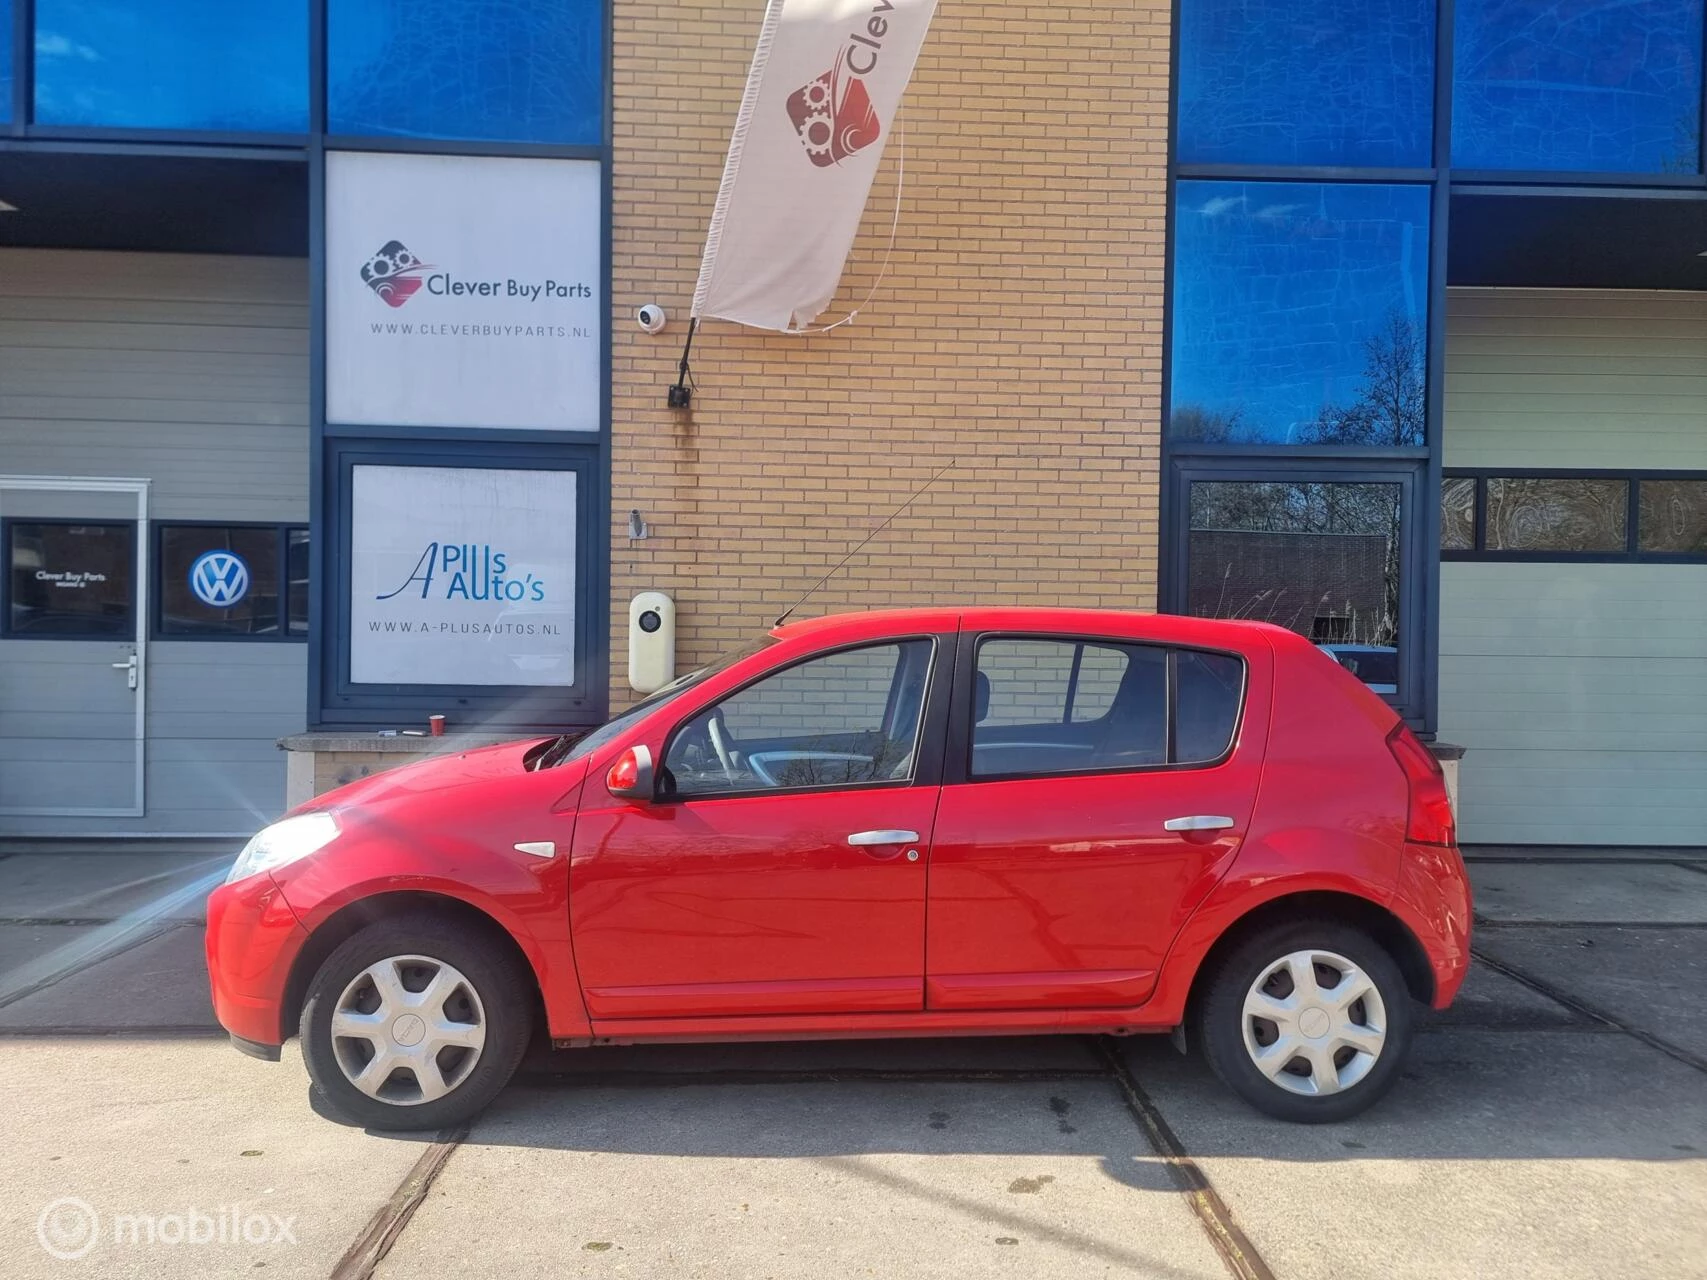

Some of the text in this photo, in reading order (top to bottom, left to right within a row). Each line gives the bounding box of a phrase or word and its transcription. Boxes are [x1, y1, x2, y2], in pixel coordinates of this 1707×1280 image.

[427, 273, 592, 302] Clever Buy Parts
[371, 323, 591, 338] WWW.CLEVERBUYPARTS.NL
[376, 542, 438, 600] A
[369, 622, 560, 635] WWW.A-PLUSAUTOS.NL
